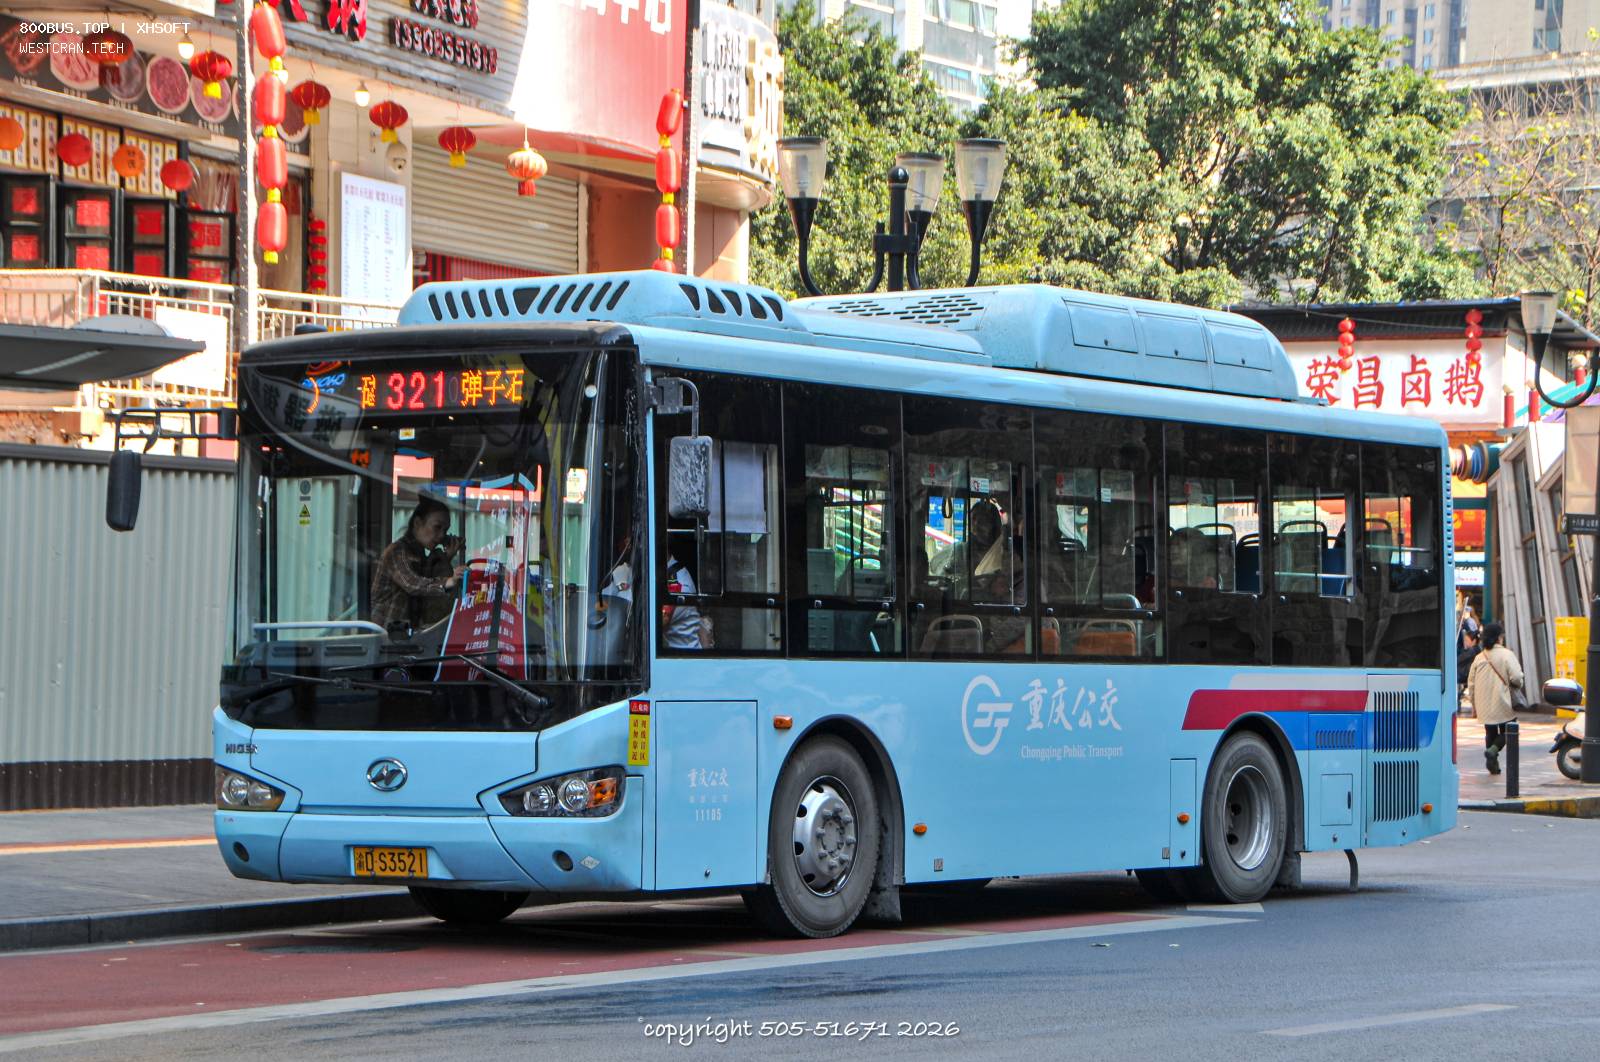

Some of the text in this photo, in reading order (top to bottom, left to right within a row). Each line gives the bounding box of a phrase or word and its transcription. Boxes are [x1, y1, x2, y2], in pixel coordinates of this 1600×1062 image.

[387, 370, 445, 411] 321
[460, 369, 525, 407] 弹子石
[1305, 354, 1485, 409] 荣昌卤鹅
[1021, 678, 1122, 731] 重庆公交
[1021, 744, 1123, 760] Chongqing Public Transport
[687, 767, 729, 788] 重庆公交
